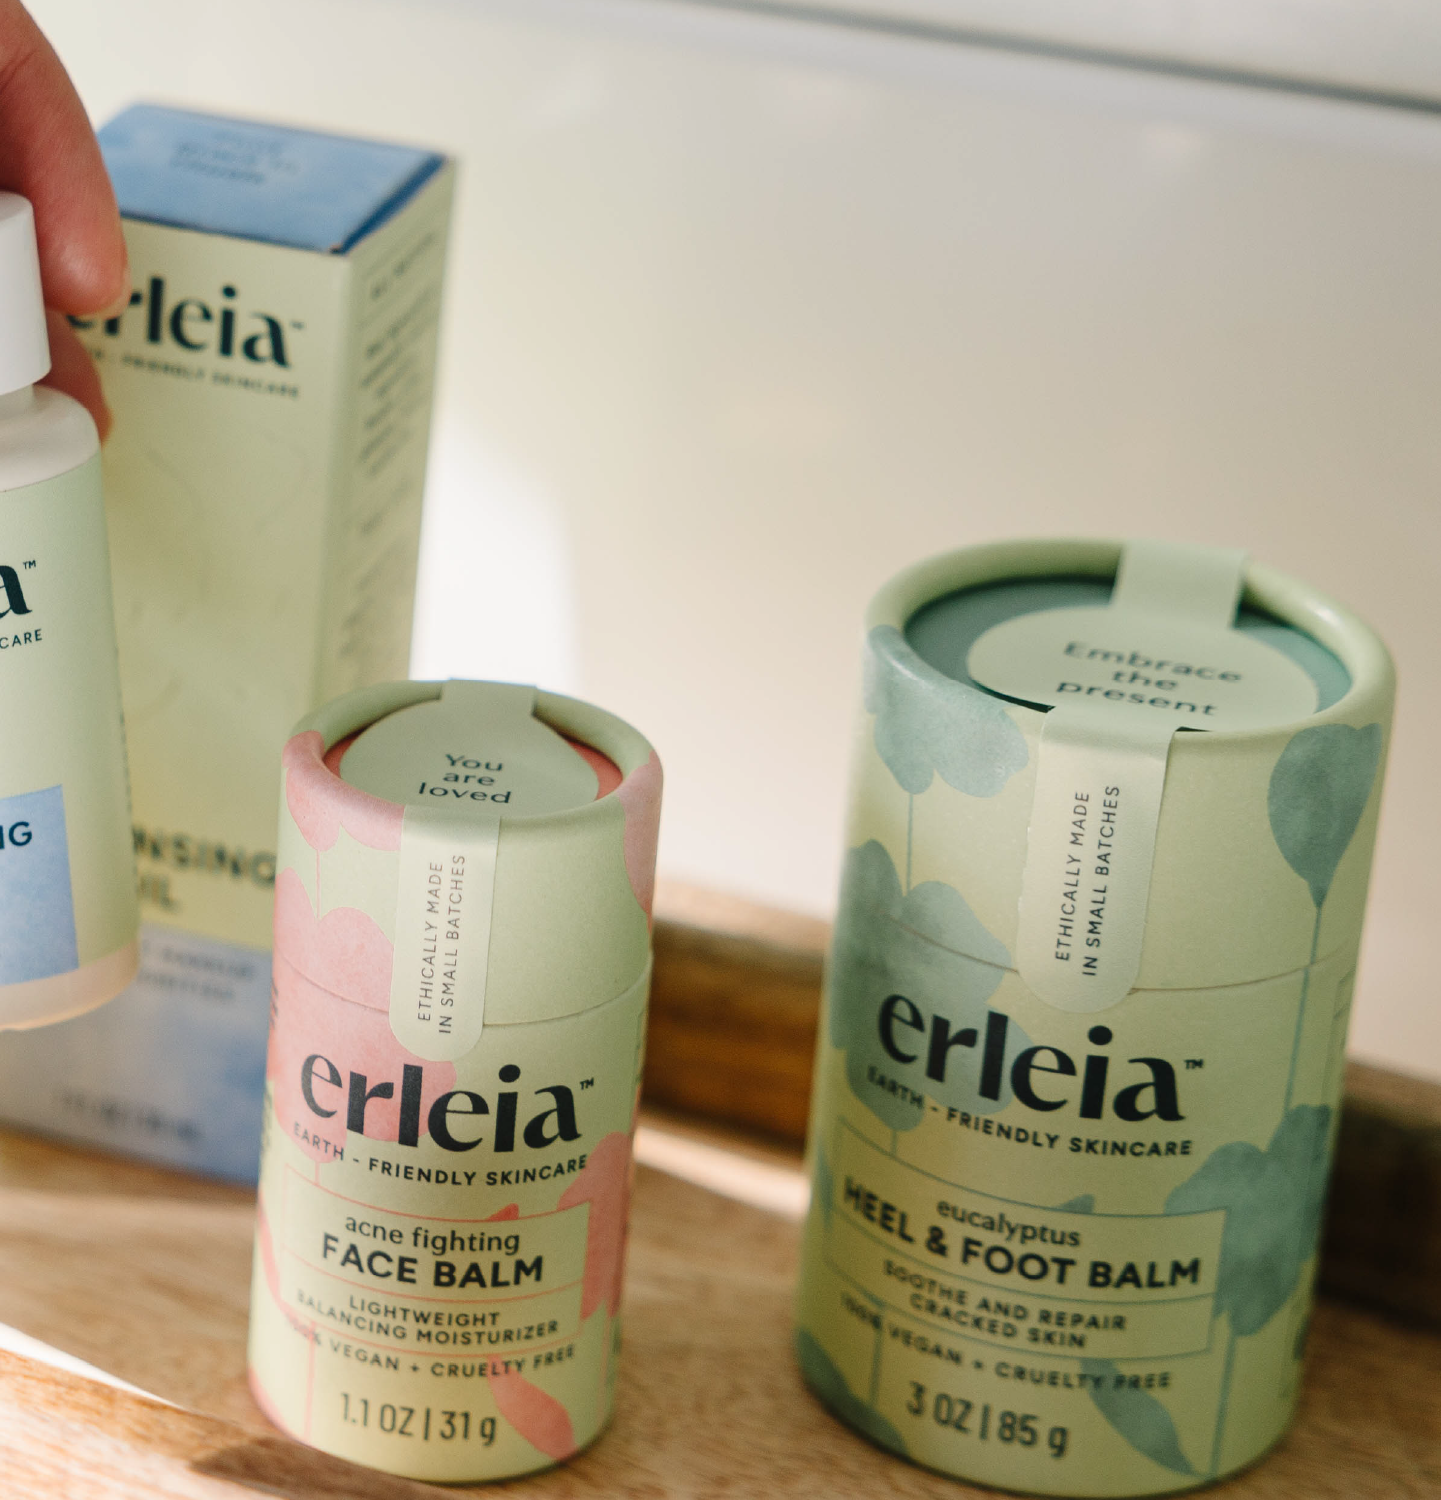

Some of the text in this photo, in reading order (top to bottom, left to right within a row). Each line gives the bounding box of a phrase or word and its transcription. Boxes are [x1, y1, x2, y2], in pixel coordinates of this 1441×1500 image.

[66, 277, 291, 368] rleia
[1063, 641, 1243, 685] Embrace
[1111, 670, 1179, 691] the
[1055, 679, 1217, 716] present
[443, 772, 495, 787] are
[445, 754, 504, 772] You
[418, 782, 512, 804] loved
[133, 828, 277, 888] NSING
[1055, 791, 1091, 962] ETHICALLY MADE
[1082, 785, 1121, 977] IN SMALL BATCHES
[417, 861, 444, 1022] ETHICALLY MADE
[438, 854, 466, 1034] IN SMALL BATCHES
[878, 994, 1187, 1123] erleia
[300, 1054, 582, 1153] erleia
[867, 1066, 924, 1111] EARTH
[946, 1106, 1060, 1149] FRIENDLY
[1068, 1137, 1194, 1157] SKINCARE
[294, 1121, 345, 1161] EARTH
[368, 1158, 477, 1186] FRIENDLY
[486, 1153, 588, 1186] SKINCARE
[345, 1216, 521, 1256] acne fighting
[844, 1176, 1201, 1289] HEEL & FOOT BALM
[937, 1198, 1081, 1248] eucalyptus
[322, 1232, 544, 1289] FACE BALM
[297, 1289, 559, 1346] BALANCING MOISTURIZER
[349, 1295, 500, 1327] LIGHTWEIGHT
[910, 1293, 1087, 1349] CRACKED SKIN
[976, 1296, 1029, 1322] AND
[1038, 1308, 1127, 1332] REPAIR
[330, 1334, 400, 1372] VEGAN
[430, 1357, 527, 1379] CRUELTY
[533, 1343, 576, 1370] FREE
[889, 1322, 963, 1366] VEGAN
[994, 1360, 1105, 1392] CRUELTY
[1113, 1371, 1171, 1391] FREE
[341, 1393, 369, 1425] 1.1
[480, 1415, 497, 1447] g
[906, 1380, 927, 1416] 3
[1048, 1424, 1069, 1458] g
